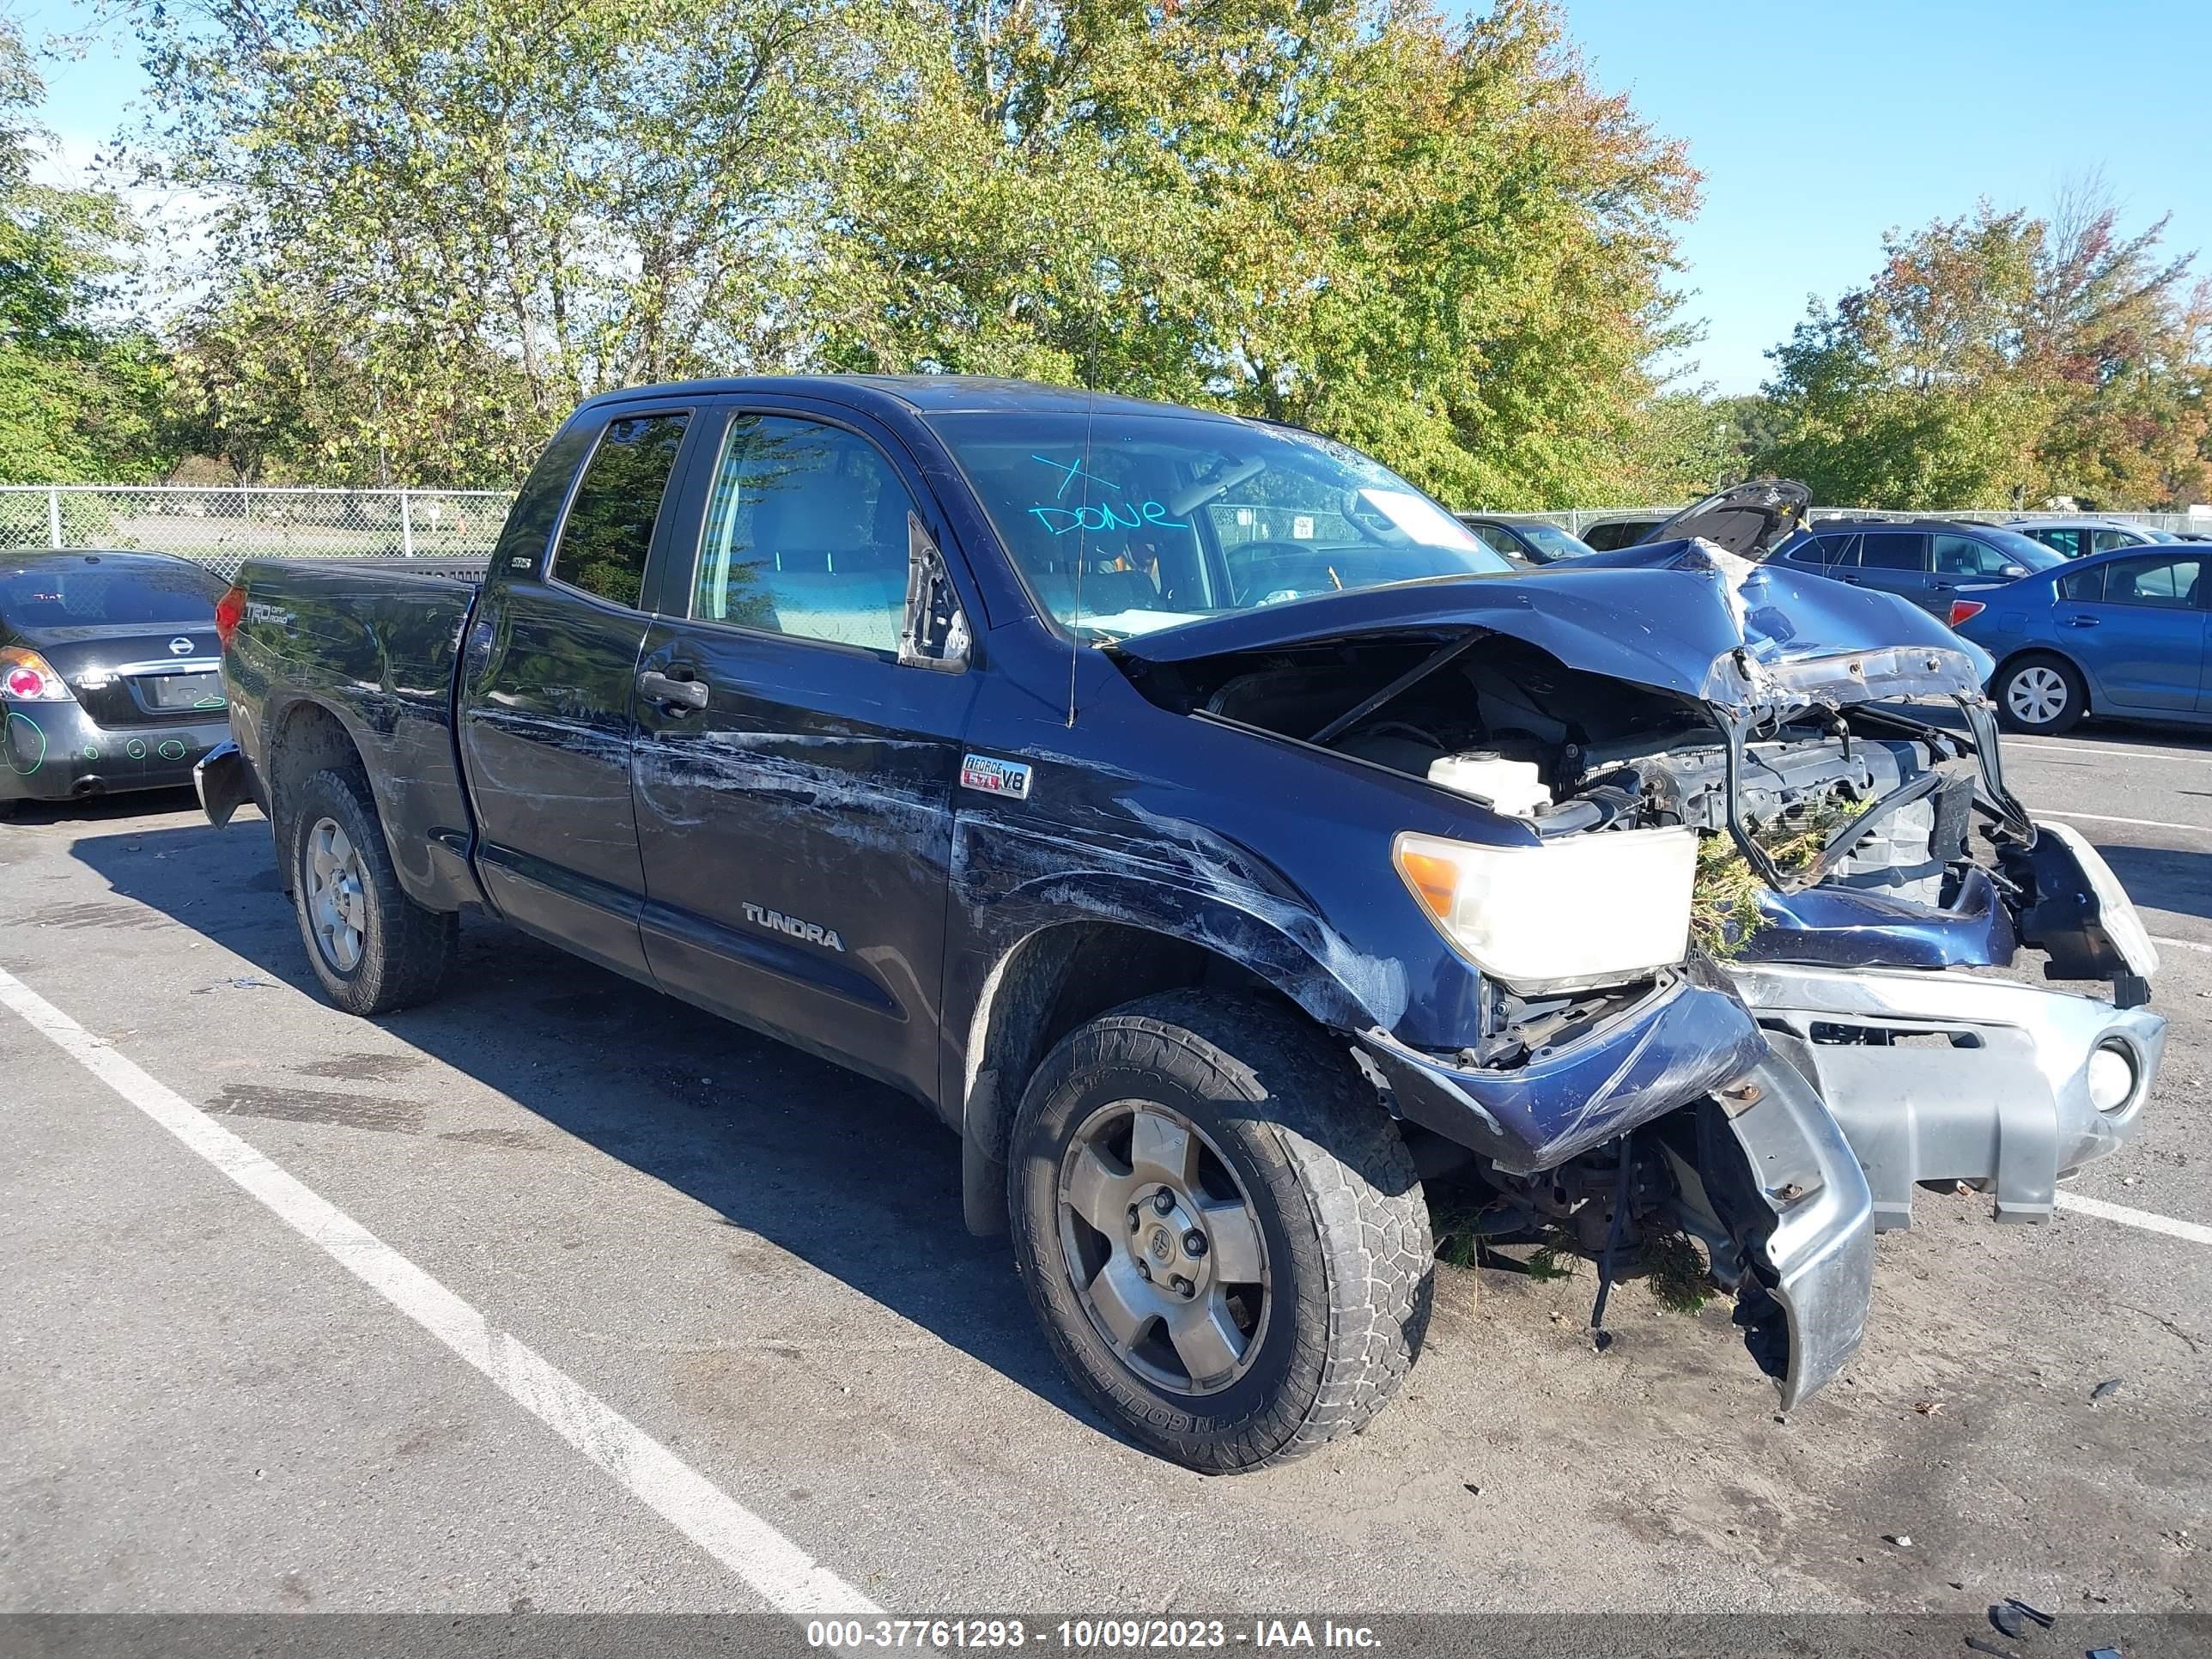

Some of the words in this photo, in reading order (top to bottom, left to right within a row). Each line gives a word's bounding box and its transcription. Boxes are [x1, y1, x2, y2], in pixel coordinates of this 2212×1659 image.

[246, 603, 270, 624] TRD
[270, 605, 285, 614] OFF
[269, 615, 288, 624] ROAD
[76, 674, 121, 684] ALMA
[1000, 769, 1024, 791] V8
[742, 902, 846, 952] TUNDRA
